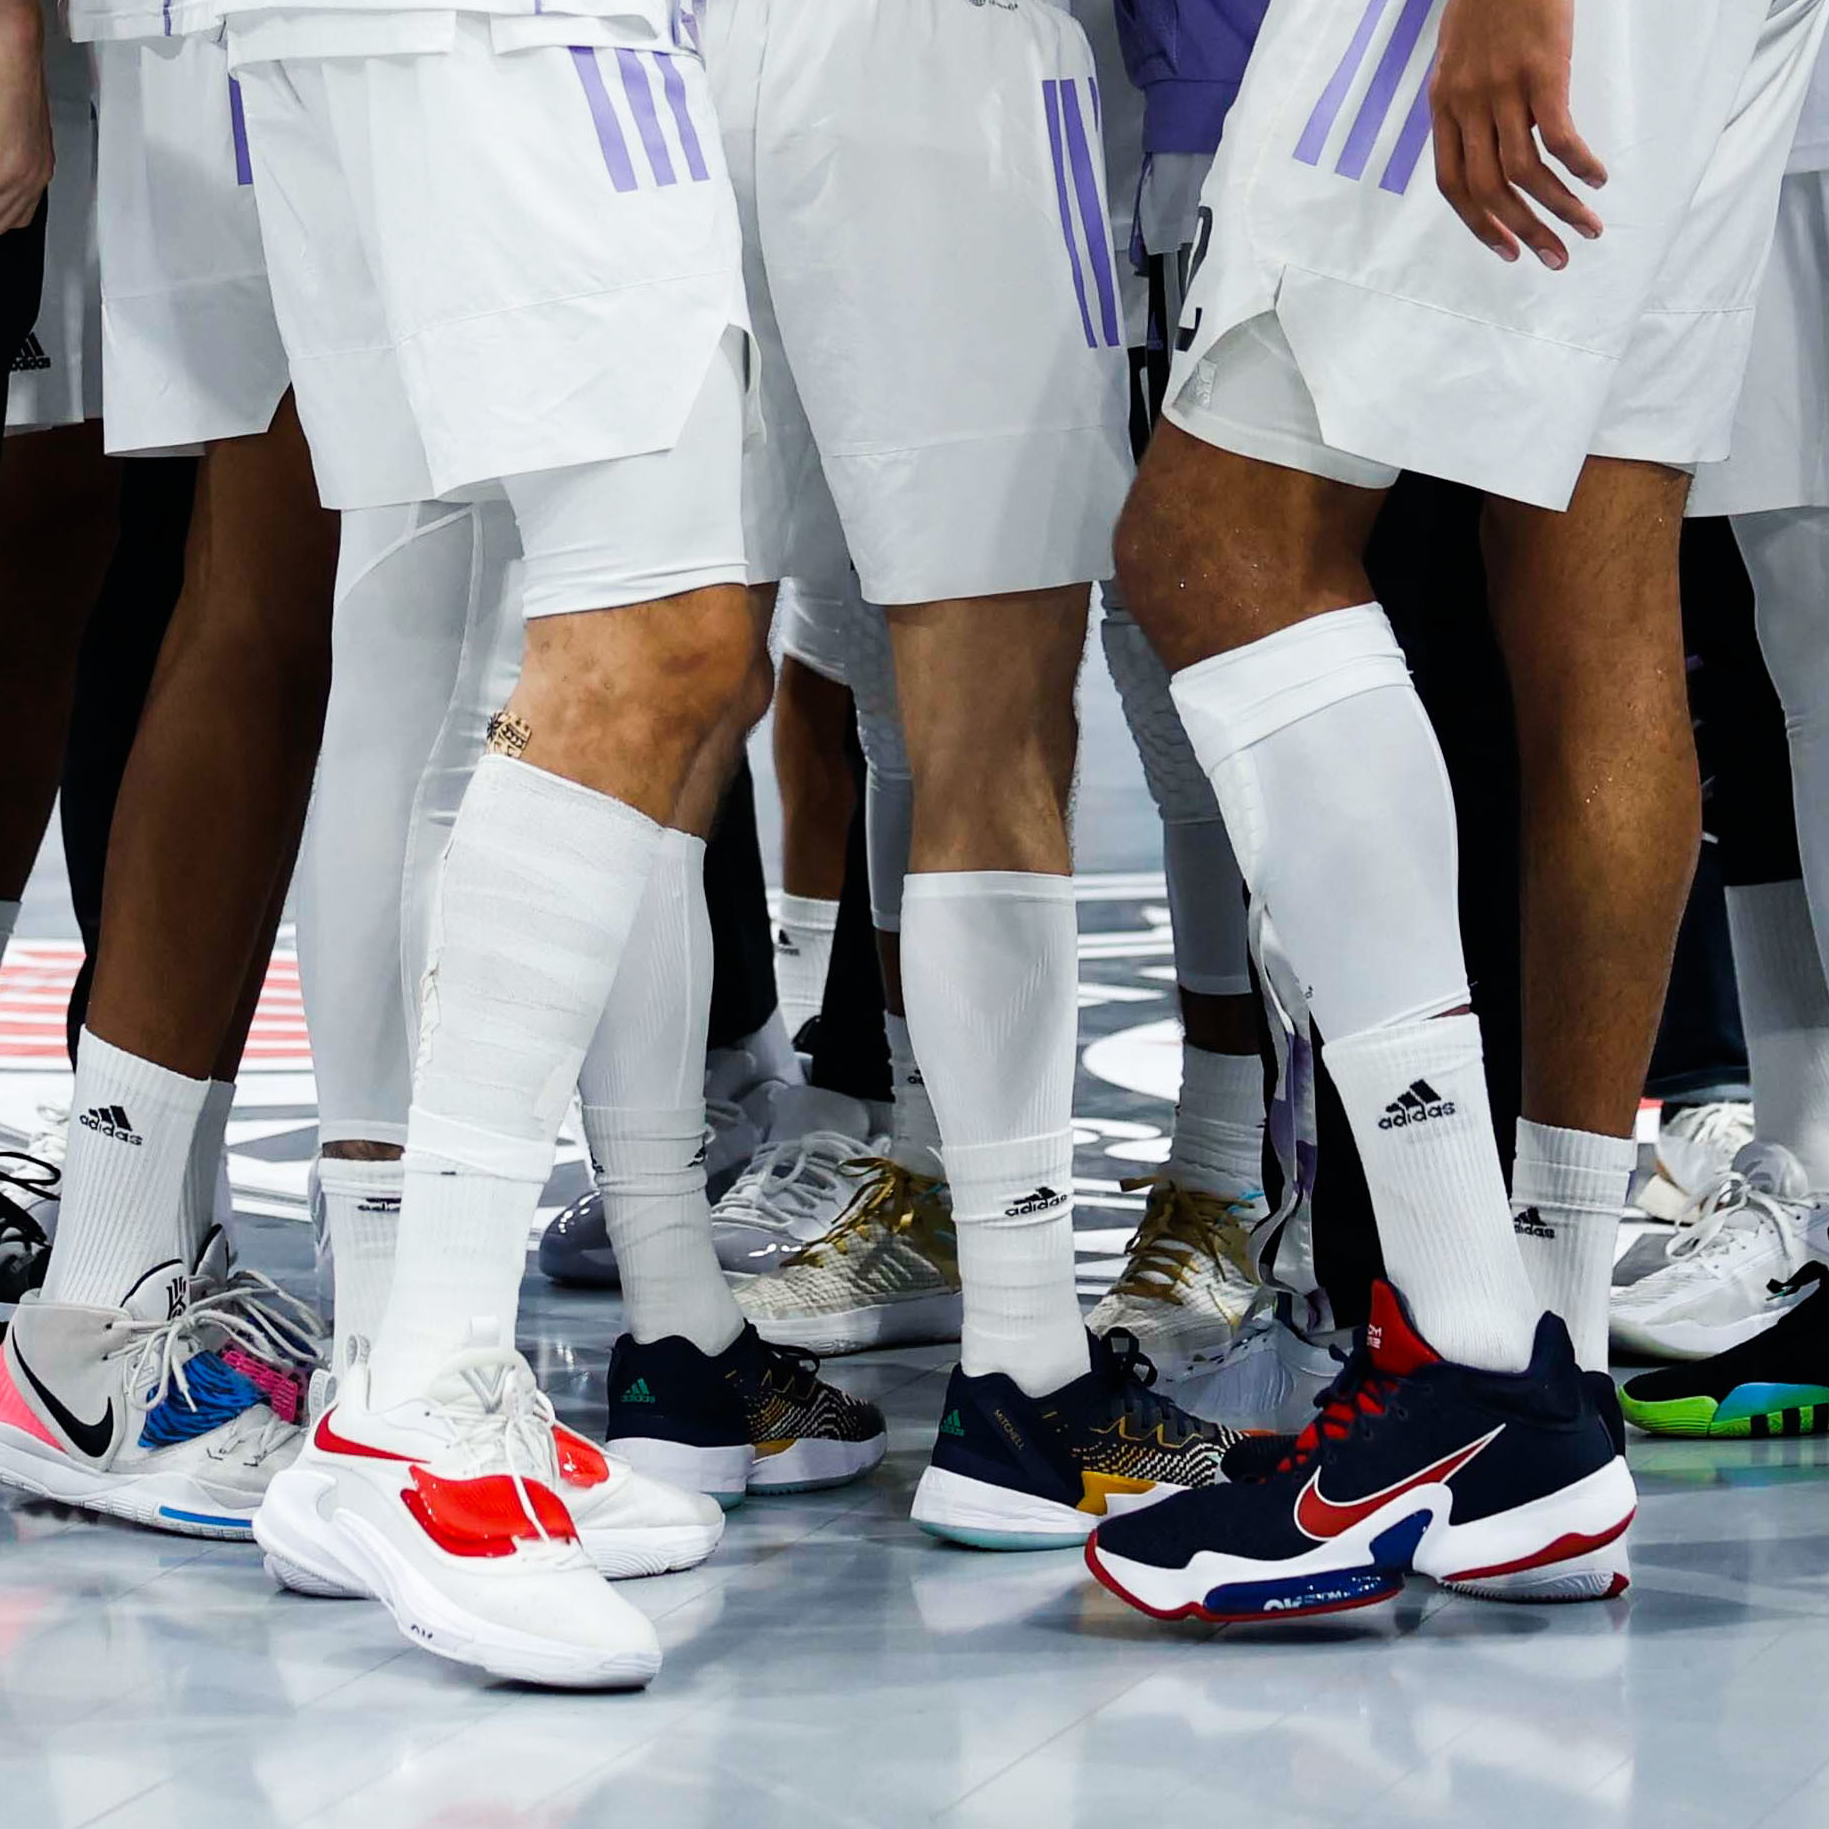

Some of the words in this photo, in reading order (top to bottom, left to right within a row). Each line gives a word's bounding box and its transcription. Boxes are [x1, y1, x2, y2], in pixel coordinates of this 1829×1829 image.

[79, 1113, 144, 1147] adidas
[1377, 1101, 1456, 1130] adidas
[1005, 1193, 1068, 1217] adidas
[995, 1408, 1025, 1451] MITCHELL
